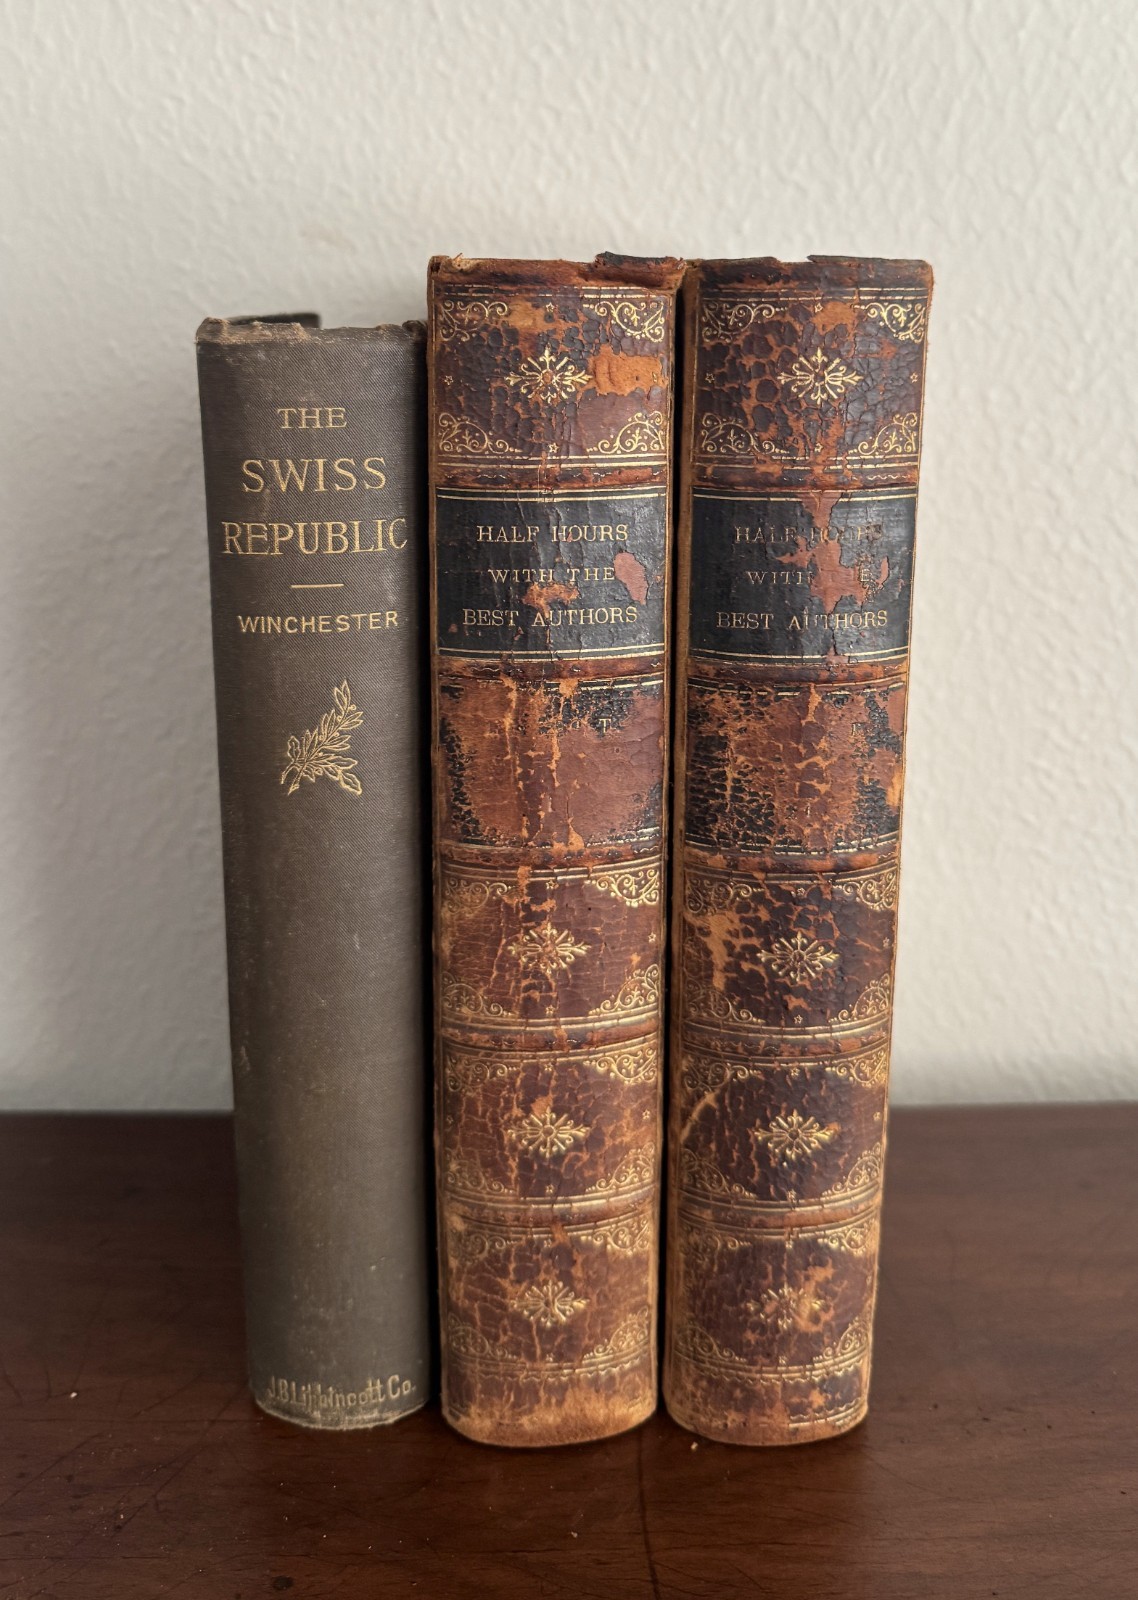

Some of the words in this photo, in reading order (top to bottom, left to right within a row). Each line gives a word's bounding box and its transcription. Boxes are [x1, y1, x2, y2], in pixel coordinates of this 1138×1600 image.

[277, 407, 347, 429] THE
[242, 456, 387, 493] SWISS
[221, 518, 408, 555] REPUBLIC
[476, 525, 539, 543] HALF
[551, 524, 629, 543] HOURS
[734, 526, 797, 544] HALF
[488, 568, 554, 584] WITH
[566, 567, 615, 583] THE
[237, 611, 398, 634] WINCHESTER
[462, 608, 519, 627] BEST
[531, 606, 638, 627] AUTHORS
[716, 611, 774, 629] BEST
[388, 1374, 417, 1399] Co.
